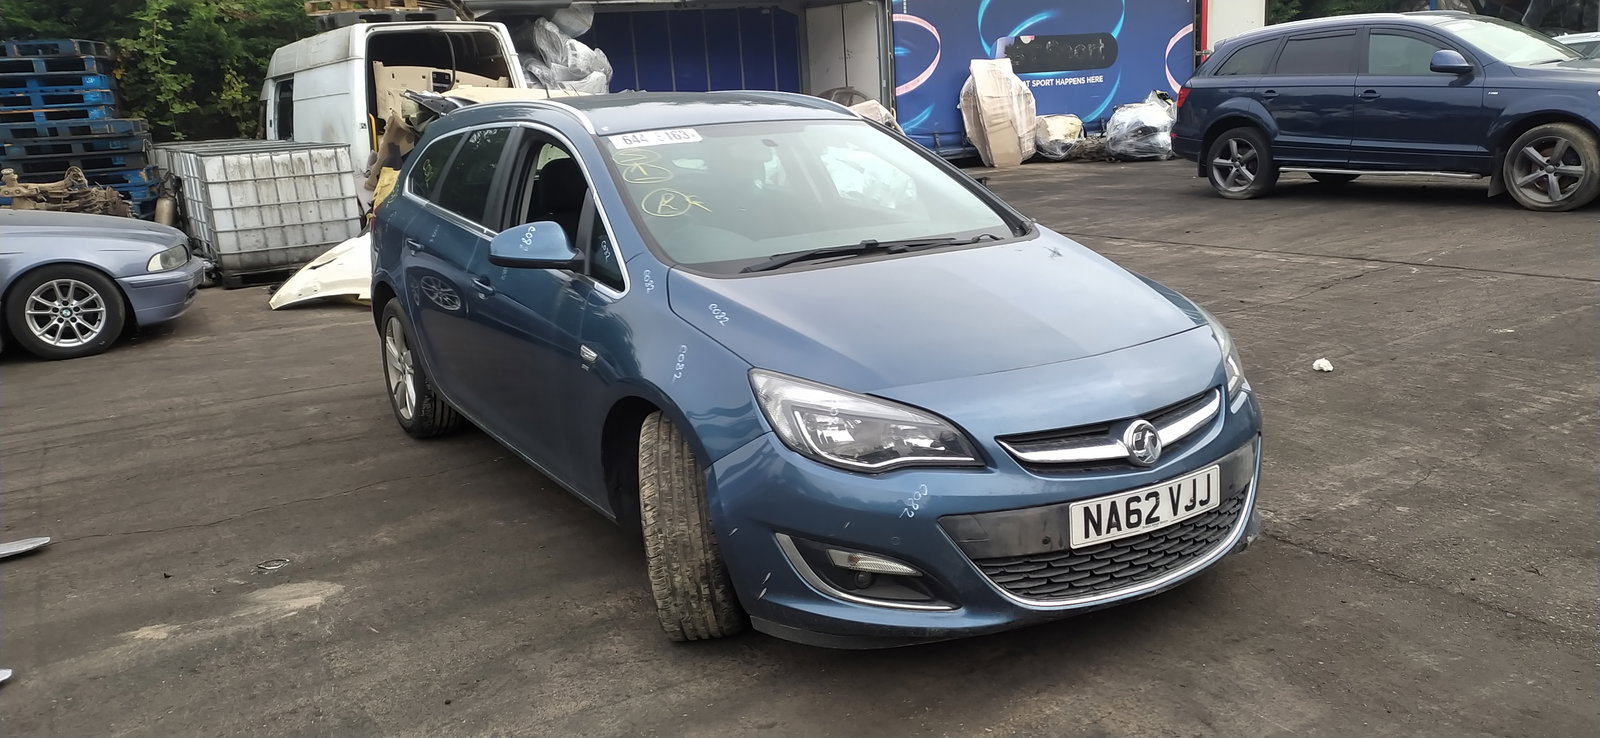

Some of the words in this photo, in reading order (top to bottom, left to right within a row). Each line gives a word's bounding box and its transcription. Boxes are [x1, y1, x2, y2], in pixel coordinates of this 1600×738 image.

[1032, 78, 1054, 87] SPORT
[1055, 76, 1085, 85] HAPPENS
[1086, 75, 1104, 83] HERE
[1083, 492, 1160, 539] NA62
[1169, 473, 1211, 517] VJJ
